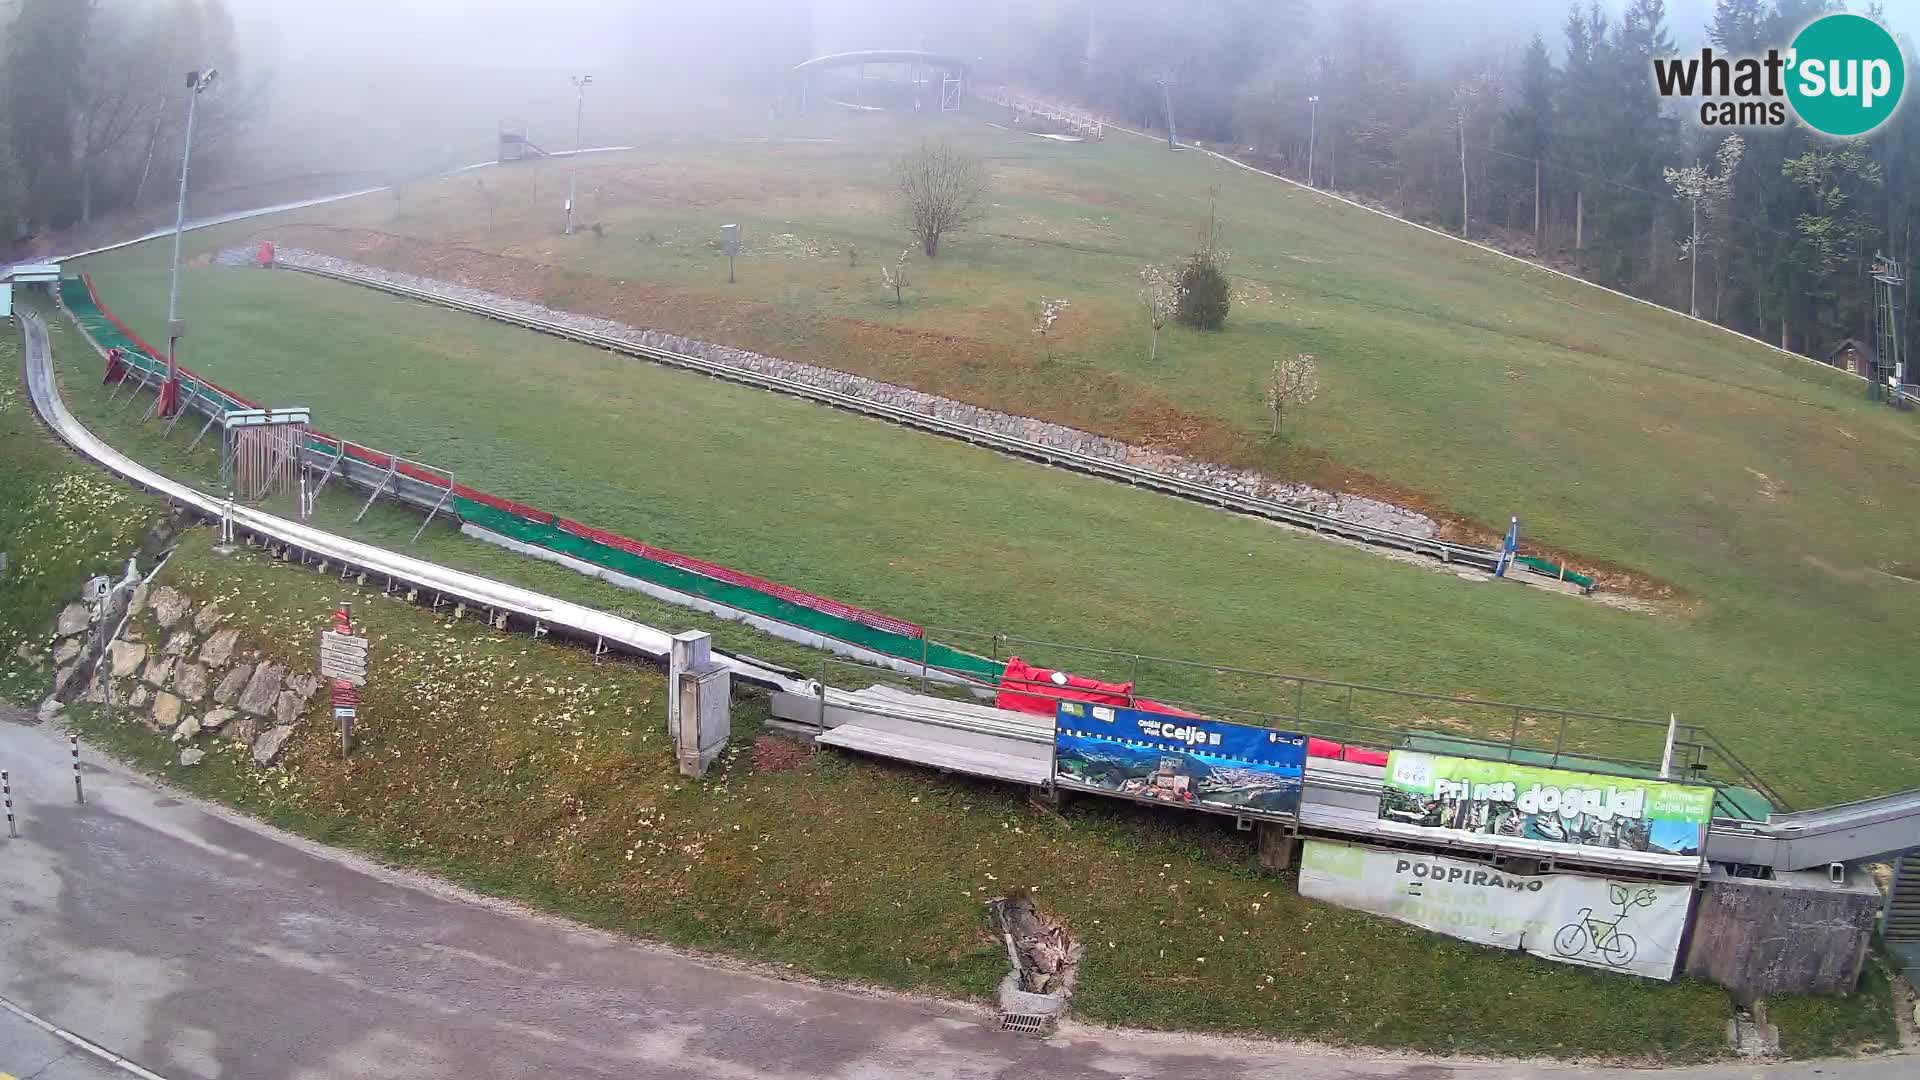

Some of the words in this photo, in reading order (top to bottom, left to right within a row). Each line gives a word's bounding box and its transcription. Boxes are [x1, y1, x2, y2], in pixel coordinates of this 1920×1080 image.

[1161, 723, 1207, 745] Celje
[1433, 778, 1470, 801] Pri
[1473, 781, 1516, 802] nas
[1517, 782, 1645, 821] dogaja!
[1395, 858, 1544, 892] PODPIRAMO
